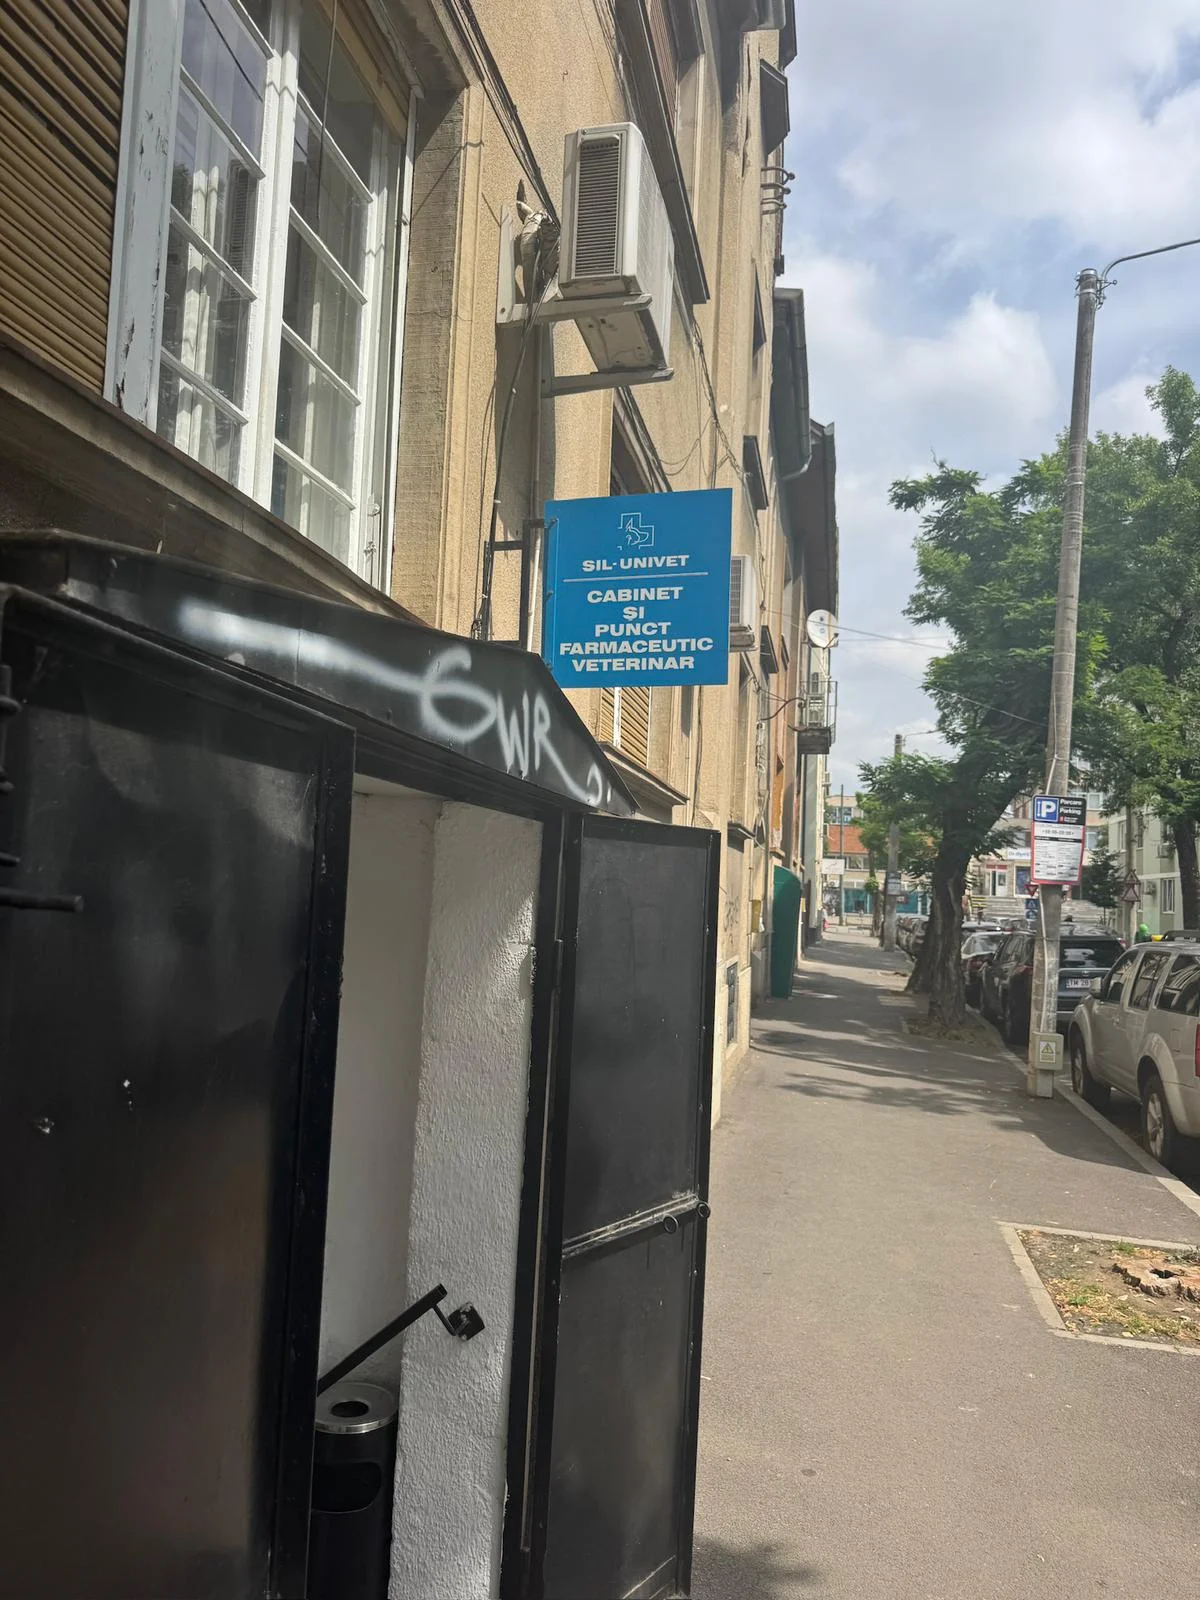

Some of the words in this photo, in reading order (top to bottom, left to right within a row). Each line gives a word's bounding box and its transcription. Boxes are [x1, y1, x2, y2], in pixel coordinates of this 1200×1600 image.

[587, 586, 684, 604] CABINET
[595, 622, 671, 637] PUNCT
[559, 638, 714, 655] FARMACEUTIC
[571, 656, 695, 672] VETERINAR
[1041, 800, 1056, 818] P
